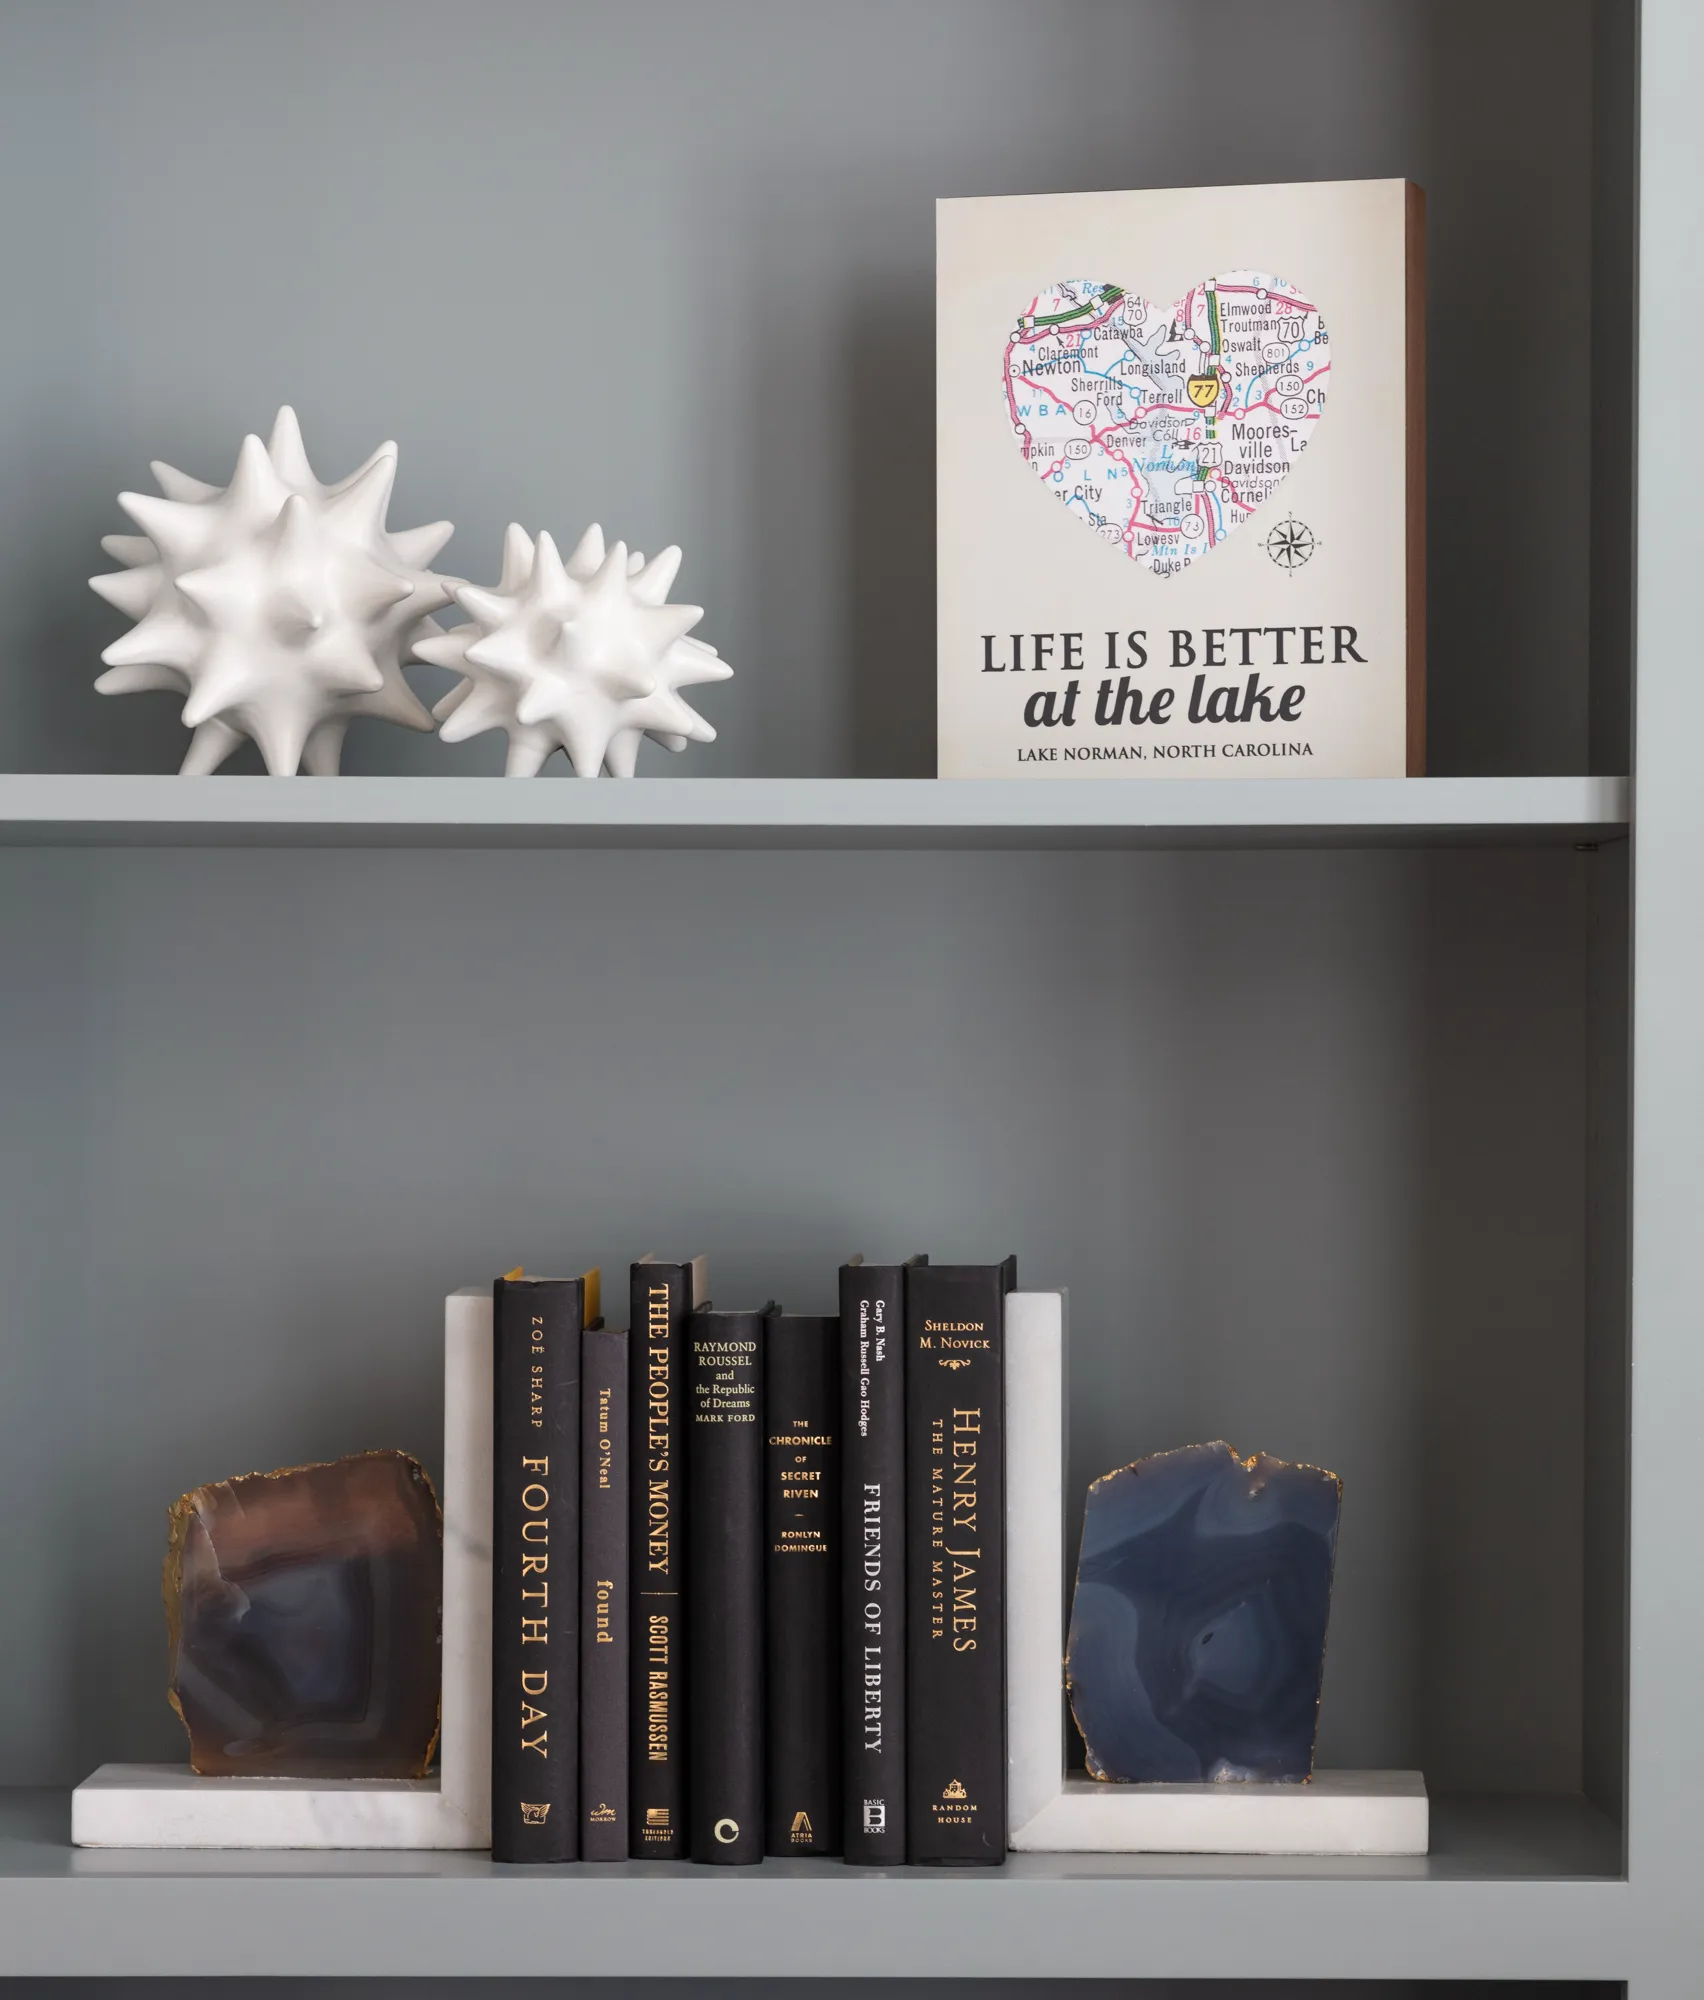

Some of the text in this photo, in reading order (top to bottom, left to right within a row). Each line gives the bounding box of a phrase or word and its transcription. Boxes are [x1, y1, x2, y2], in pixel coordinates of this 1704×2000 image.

[1053, 298, 1060, 312] 7
[1127, 296, 1141, 308] 64
[1220, 300, 1272, 317] Elmwood
[1276, 301, 1292, 315] 28
[1128, 309, 1142, 321] 70
[1176, 309, 1184, 322] 8
[1197, 304, 1205, 318] 7
[1220, 318, 1277, 333] Troutman
[1283, 321, 1300, 339] 70
[1094, 325, 1143, 341] Catawba
[1066, 334, 1081, 348] 21
[1222, 337, 1261, 353] Oswalt
[1038, 346, 1098, 361] Claremont
[1225, 355, 1232, 364] 4
[1267, 348, 1285, 359] 801
[1022, 359, 1081, 377] Newton
[1121, 359, 1186, 377] Longisland
[1235, 359, 1299, 378] Shepherds
[1307, 361, 1314, 371] 9
[1071, 376, 1123, 392] Sherrills
[1194, 384, 1215, 398] 77
[1235, 383, 1242, 392] 4
[1280, 381, 1300, 391] 150
[1096, 392, 1123, 406] Ford
[1141, 389, 1182, 404] Terrell
[1233, 397, 1240, 407] 2
[1254, 390, 1262, 400] 3
[1306, 389, 1325, 404] Ch
[1080, 408, 1091, 418] 16
[1193, 410, 1200, 420] 9
[1285, 404, 1304, 414] 152
[1129, 416, 1187, 430] Davidson
[1186, 427, 1201, 441] 16
[1232, 423, 1298, 441] Moores-
[1107, 434, 1147, 448] Denver
[1068, 445, 1088, 456] 150
[1202, 447, 1218, 464] 21
[1239, 441, 1273, 459] ville
[1121, 467, 1128, 477] 5
[1224, 457, 1291, 475] Davidson
[1221, 475, 1280, 489] Davidson
[1074, 485, 1103, 502] City
[1140, 497, 1192, 515] Triangle
[1185, 521, 1200, 532] 73
[1152, 544, 1178, 556] Mtn
[1153, 558, 1181, 574] Duke
[981, 625, 1368, 672] LIFE IS BETTER
[1024, 672, 1306, 728] at the lake
[1017, 742, 1314, 762] LAKE NORMAN, NORTH CAROLINA
[874, 1300, 885, 1361] Gary B. Nash
[924, 1319, 984, 1332] SHELDON
[693, 1341, 757, 1352] RAYMOND
[919, 1337, 990, 1349] M. NOVICK
[698, 1356, 752, 1366] ROUSSEL
[715, 1370, 735, 1380] and
[858, 1300, 870, 1437] Graham Russell Gao Hodges
[531, 1365, 544, 1428] SHARP
[695, 1384, 755, 1396] the Republic
[700, 1398, 750, 1408] of Dreams
[695, 1414, 756, 1422] MARK FORD
[648, 1283, 670, 1575] THE PEOPLE'S MONEY
[599, 1387, 611, 1489] Tatum O'Neal
[769, 1436, 832, 1446] CHRONICLE
[780, 1471, 821, 1481] SECRET
[783, 1489, 819, 1498] RIVEN
[932, 1419, 943, 1639] THE MATURE MASTER
[945, 1408, 981, 1652] HENRY JAMES
[774, 1544, 828, 1552] DOMINGUE
[521, 1455, 549, 1759] FOURTH DAY
[597, 1580, 614, 1643] found
[864, 1484, 882, 1753] FRIENDS OF LIBERTY
[648, 1615, 669, 1761] SCOTT RASMUSSEN
